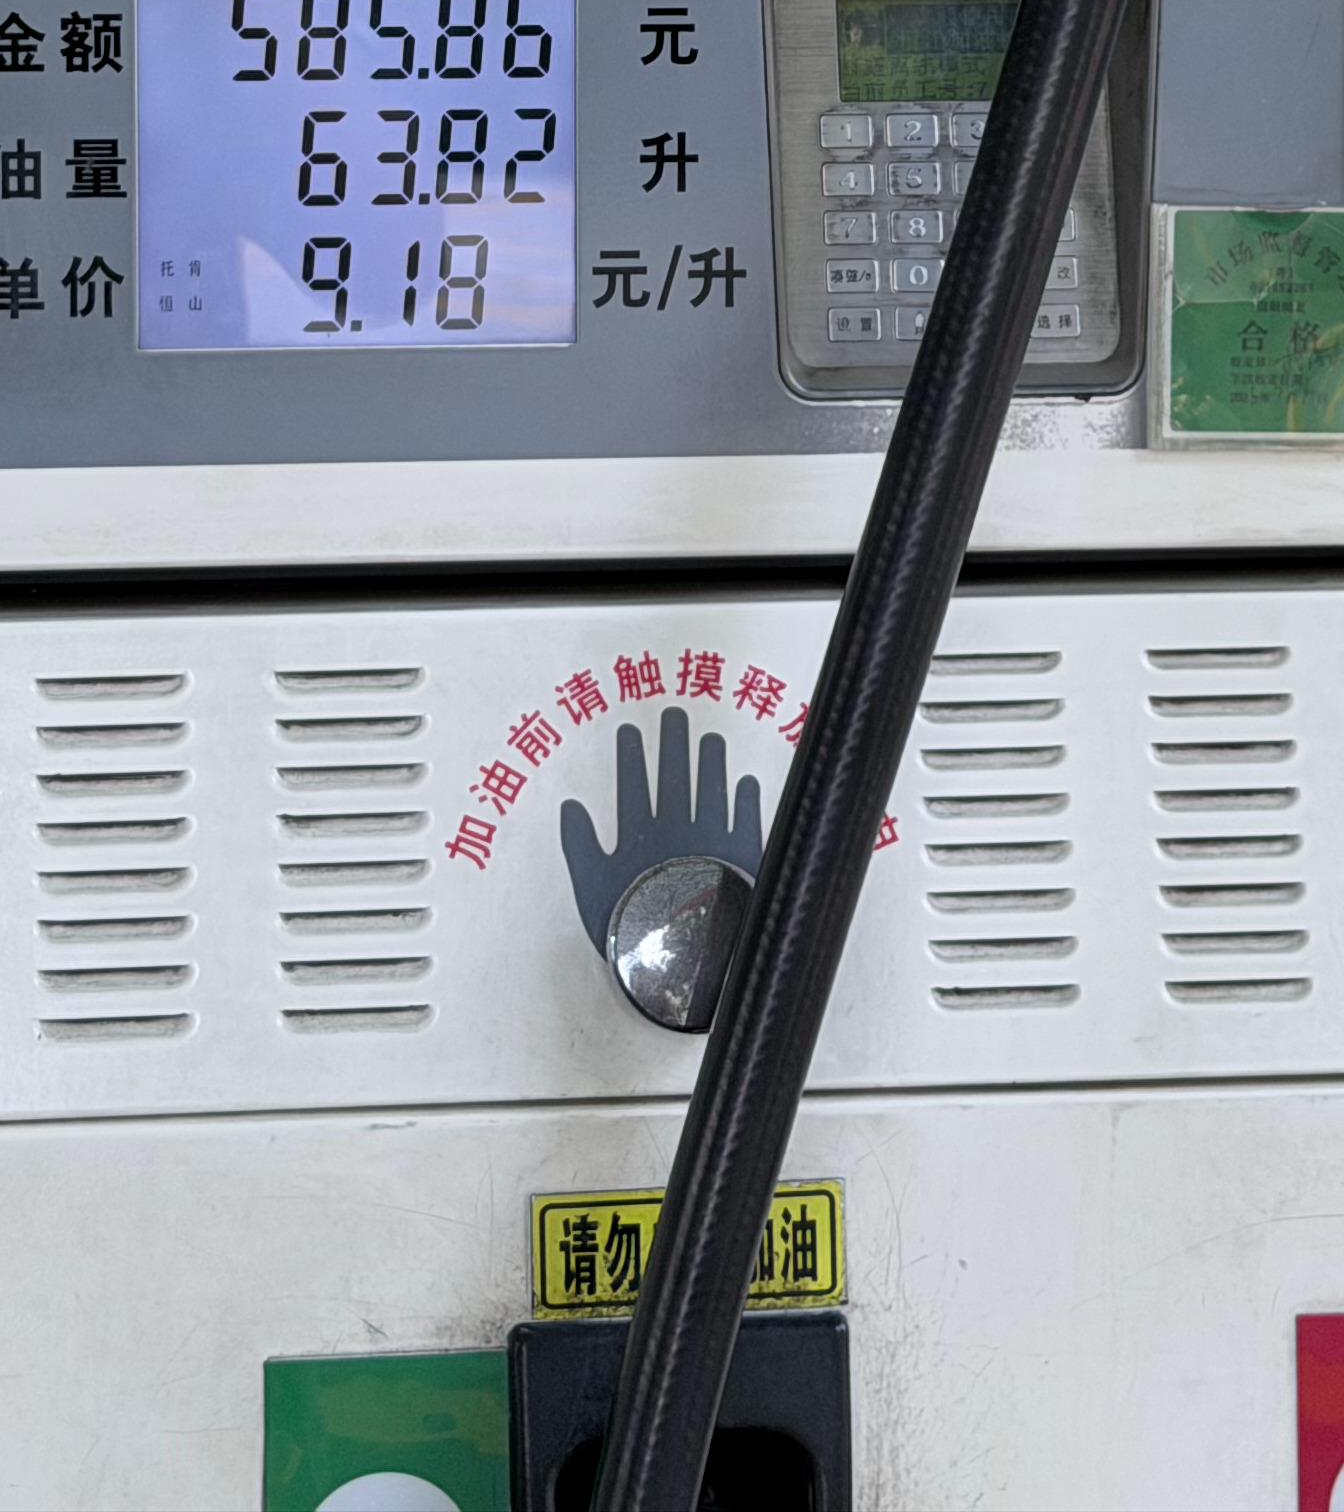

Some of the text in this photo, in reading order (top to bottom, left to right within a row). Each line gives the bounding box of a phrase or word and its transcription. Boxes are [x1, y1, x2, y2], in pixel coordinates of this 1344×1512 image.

[640, 7, 699, 66] 元
[840, 121, 852, 143] 1
[904, 120, 922, 141] 2
[298, 108, 556, 206] 63.82
[640, 131, 699, 192] 升
[839, 171, 858, 190] 4
[841, 217, 858, 238] 7
[908, 217, 926, 237] 8
[302, 234, 488, 332] 9.18
[592, 244, 747, 310] 元/升
[909, 265, 928, 285] 0
